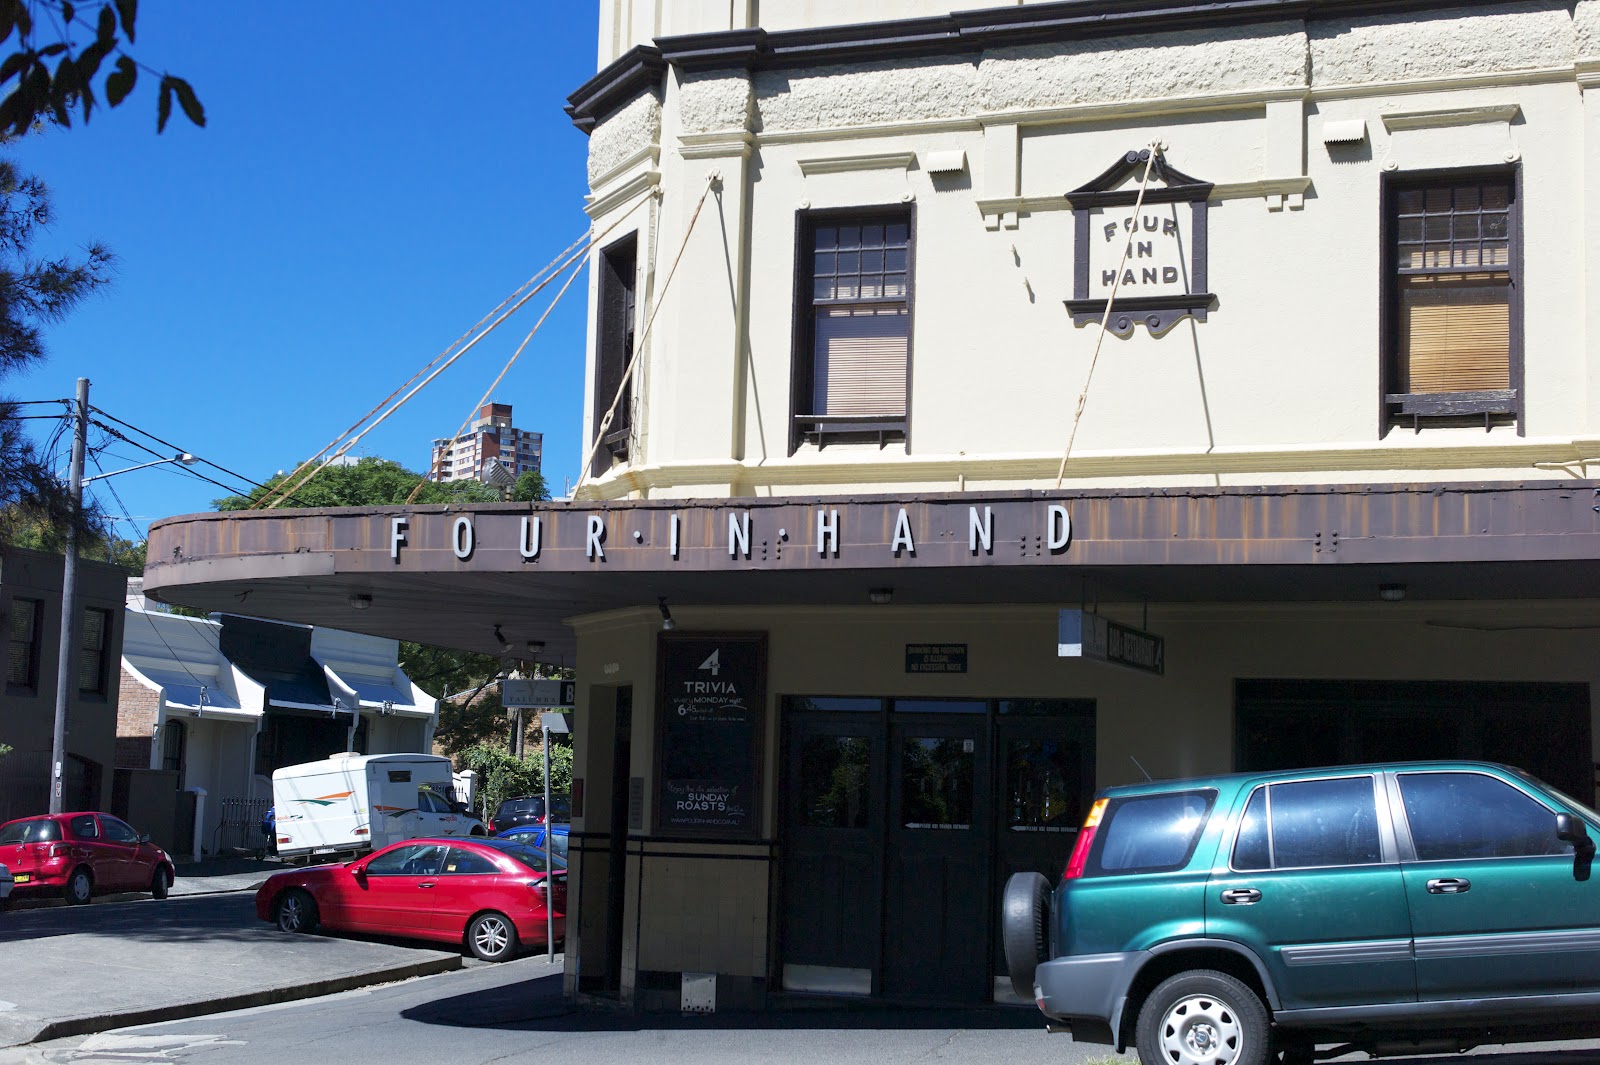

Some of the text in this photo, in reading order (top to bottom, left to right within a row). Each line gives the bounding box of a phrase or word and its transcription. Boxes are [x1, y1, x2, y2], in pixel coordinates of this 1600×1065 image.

[1104, 216, 1176, 243] FOUR
[1126, 241, 1152, 259] IN
[1102, 266, 1178, 287] HAND
[391, 504, 1071, 559] FOUR IN HAND
[684, 681, 736, 694] TRIVIA
[676, 801, 726, 811] ROASTS
[688, 792, 729, 802] SUNDAY
